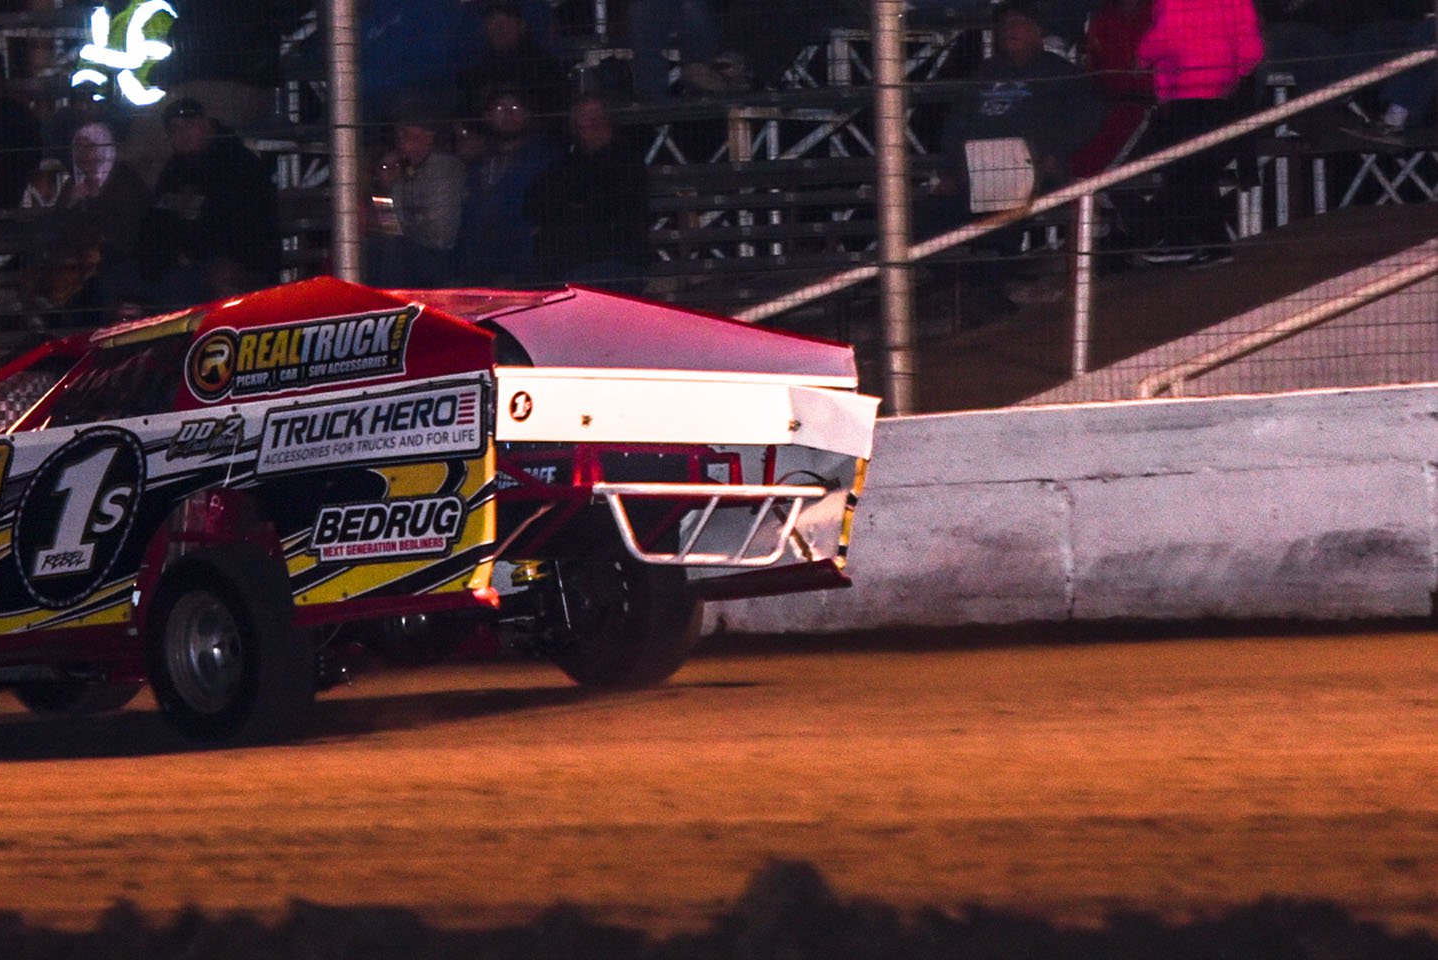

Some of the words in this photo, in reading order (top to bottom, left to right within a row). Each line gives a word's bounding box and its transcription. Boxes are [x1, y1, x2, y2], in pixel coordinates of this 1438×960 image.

[236, 316, 397, 372] REALTRUCK
[235, 372, 269, 388] PICKUP
[279, 368, 298, 382] CAR
[308, 362, 328, 378] SUV
[327, 355, 388, 376] ACCESSORIES
[271, 406, 367, 449] TRUCK
[369, 395, 458, 435] HERO
[263, 445, 331, 466] ACCESSORIES
[332, 441, 354, 455] FOR
[357, 436, 396, 452] TRUCKS
[398, 433, 424, 448] AND
[426, 431, 449, 445] FOR
[452, 429, 476, 443] LIFE
[313, 499, 460, 546] BEDRUG
[41, 550, 86, 570] REBEL
[322, 545, 344, 558] NEXT
[345, 541, 397, 556] GENERATION
[399, 537, 444, 551] BEDLINERS
